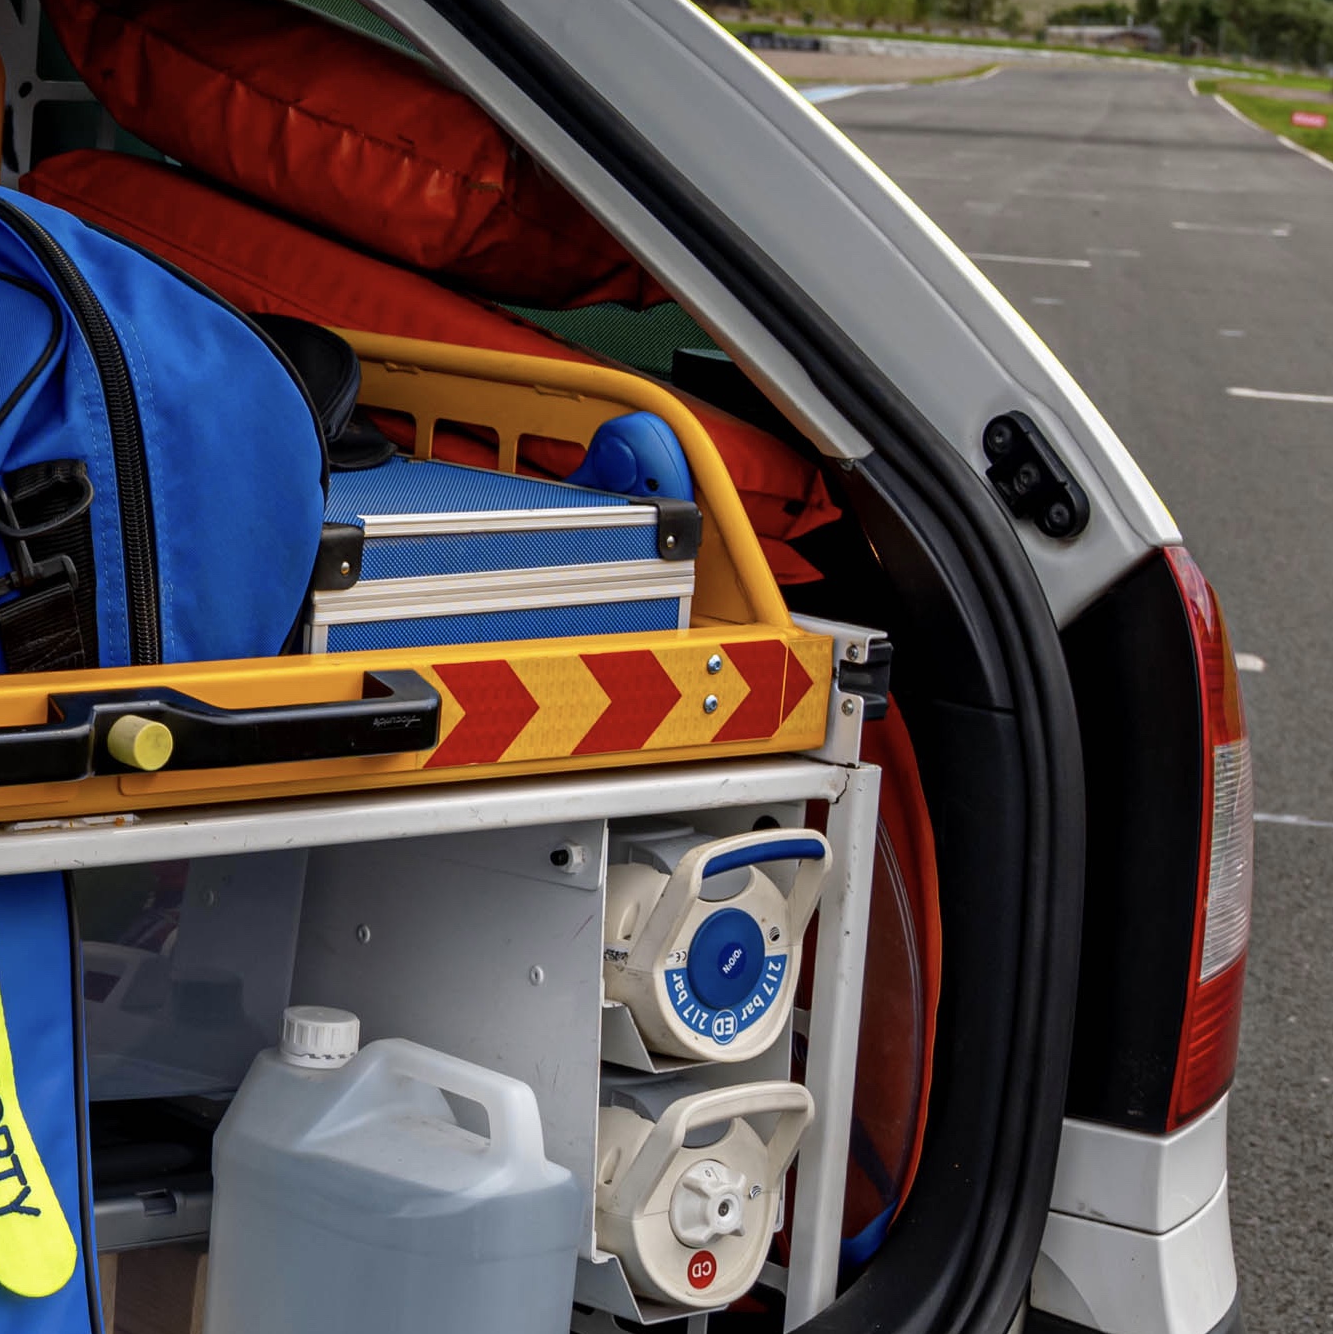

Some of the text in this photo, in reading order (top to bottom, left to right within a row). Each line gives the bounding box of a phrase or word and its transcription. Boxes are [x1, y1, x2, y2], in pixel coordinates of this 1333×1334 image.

[672, 972, 689, 1005] bar
[740, 996, 765, 1021] bar
[713, 1017, 735, 1036] ED
[692, 1261, 712, 1278] CD
